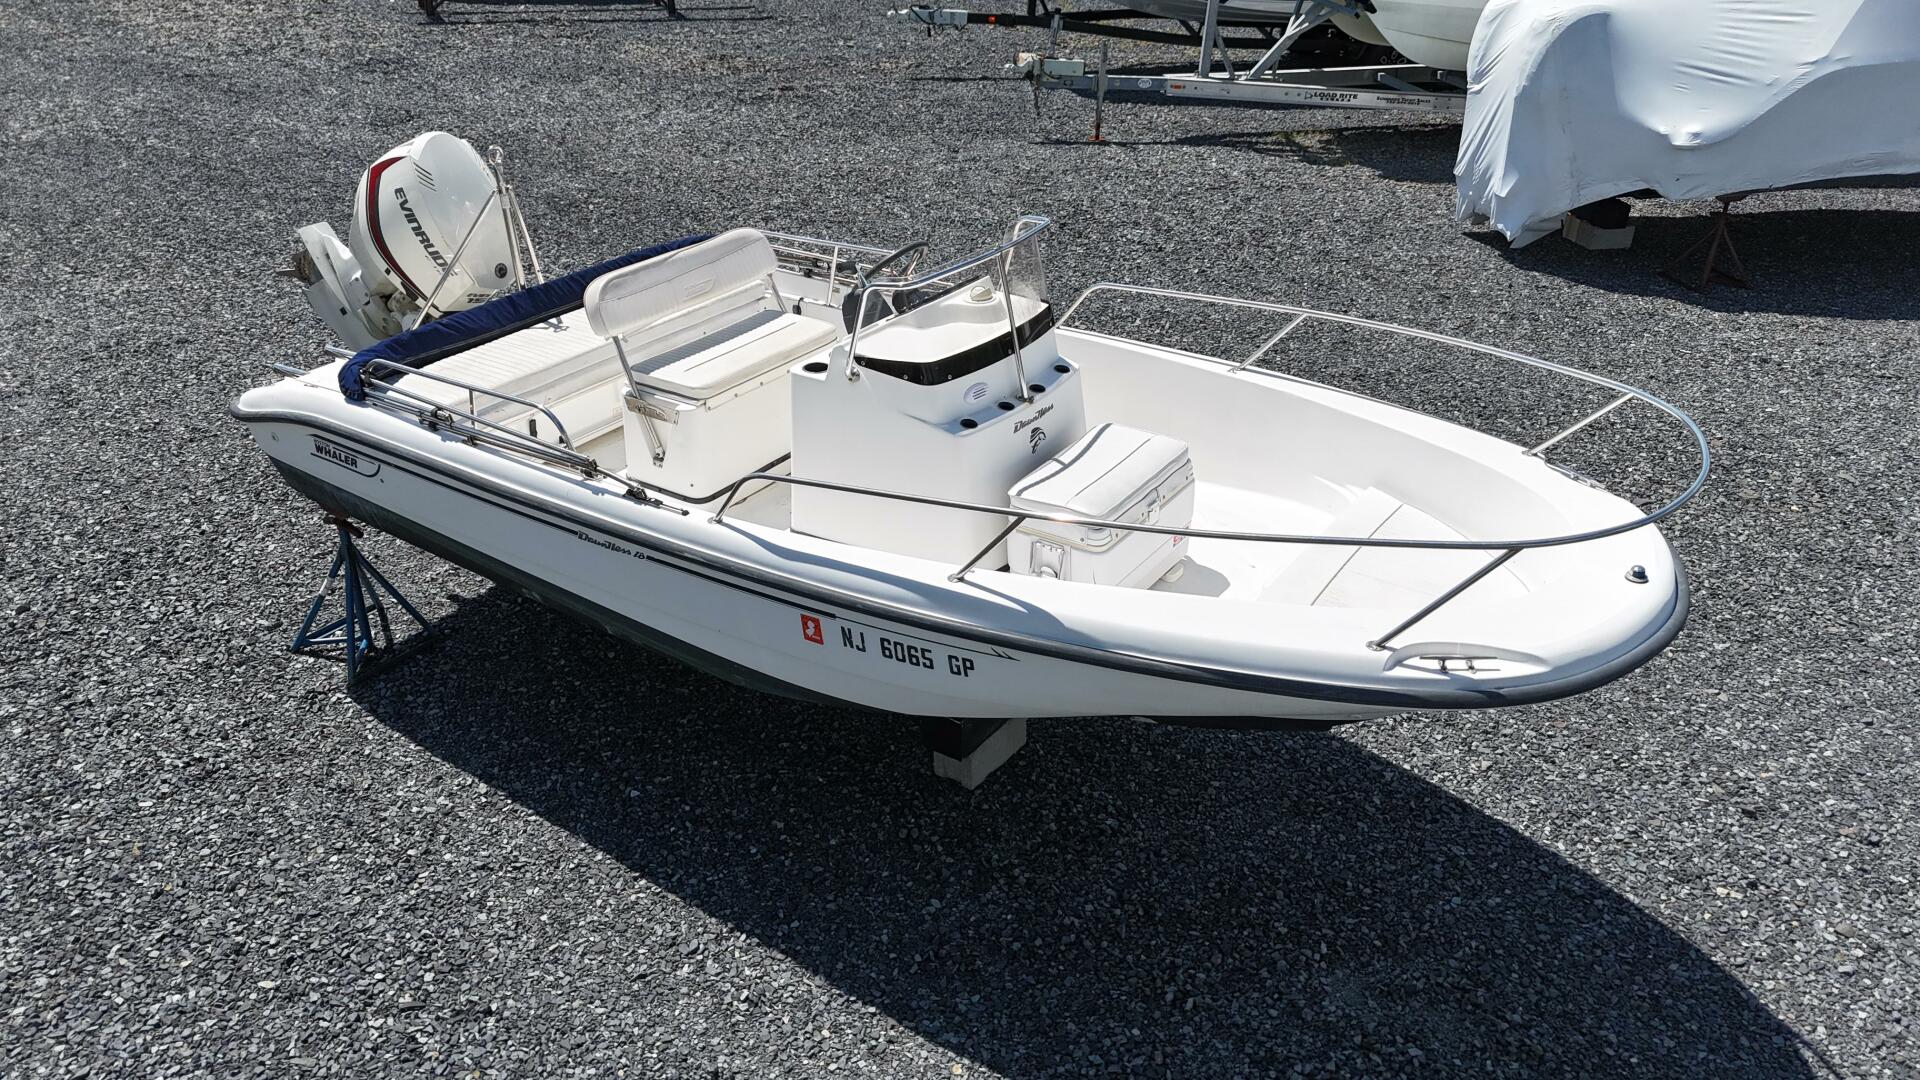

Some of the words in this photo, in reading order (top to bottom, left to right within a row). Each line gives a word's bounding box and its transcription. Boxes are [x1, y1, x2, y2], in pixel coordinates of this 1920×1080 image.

[1313, 91, 1338, 99] LOAD
[314, 443, 358, 469] WHALER
[840, 625, 867, 653] NJ
[879, 636, 935, 671] 6065
[947, 654, 975, 678] GP
